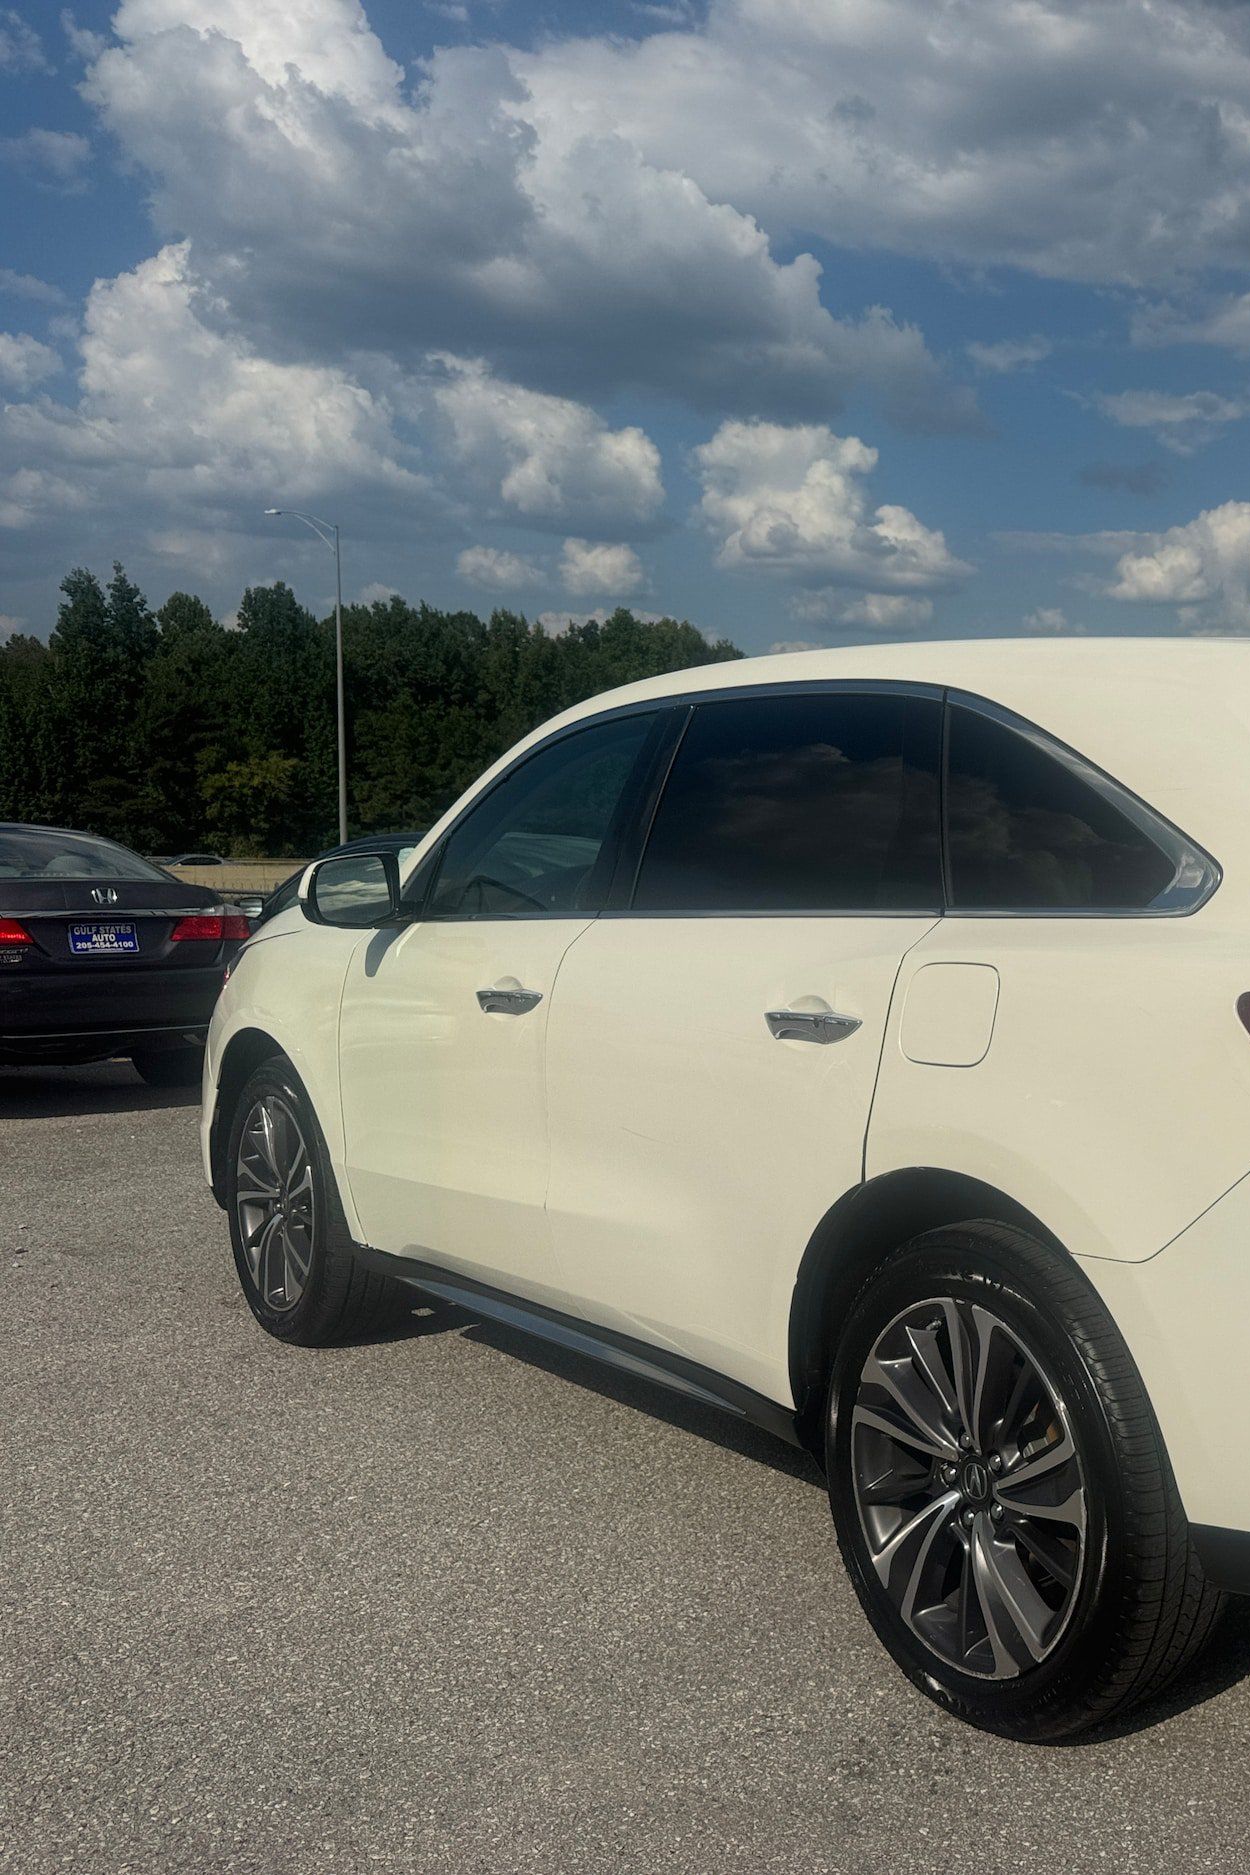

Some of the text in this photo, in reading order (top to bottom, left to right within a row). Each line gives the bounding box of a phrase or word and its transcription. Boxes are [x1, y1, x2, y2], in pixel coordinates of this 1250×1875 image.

[73, 925, 132, 936] GULF STATES
[91, 933, 116, 942] AUTO
